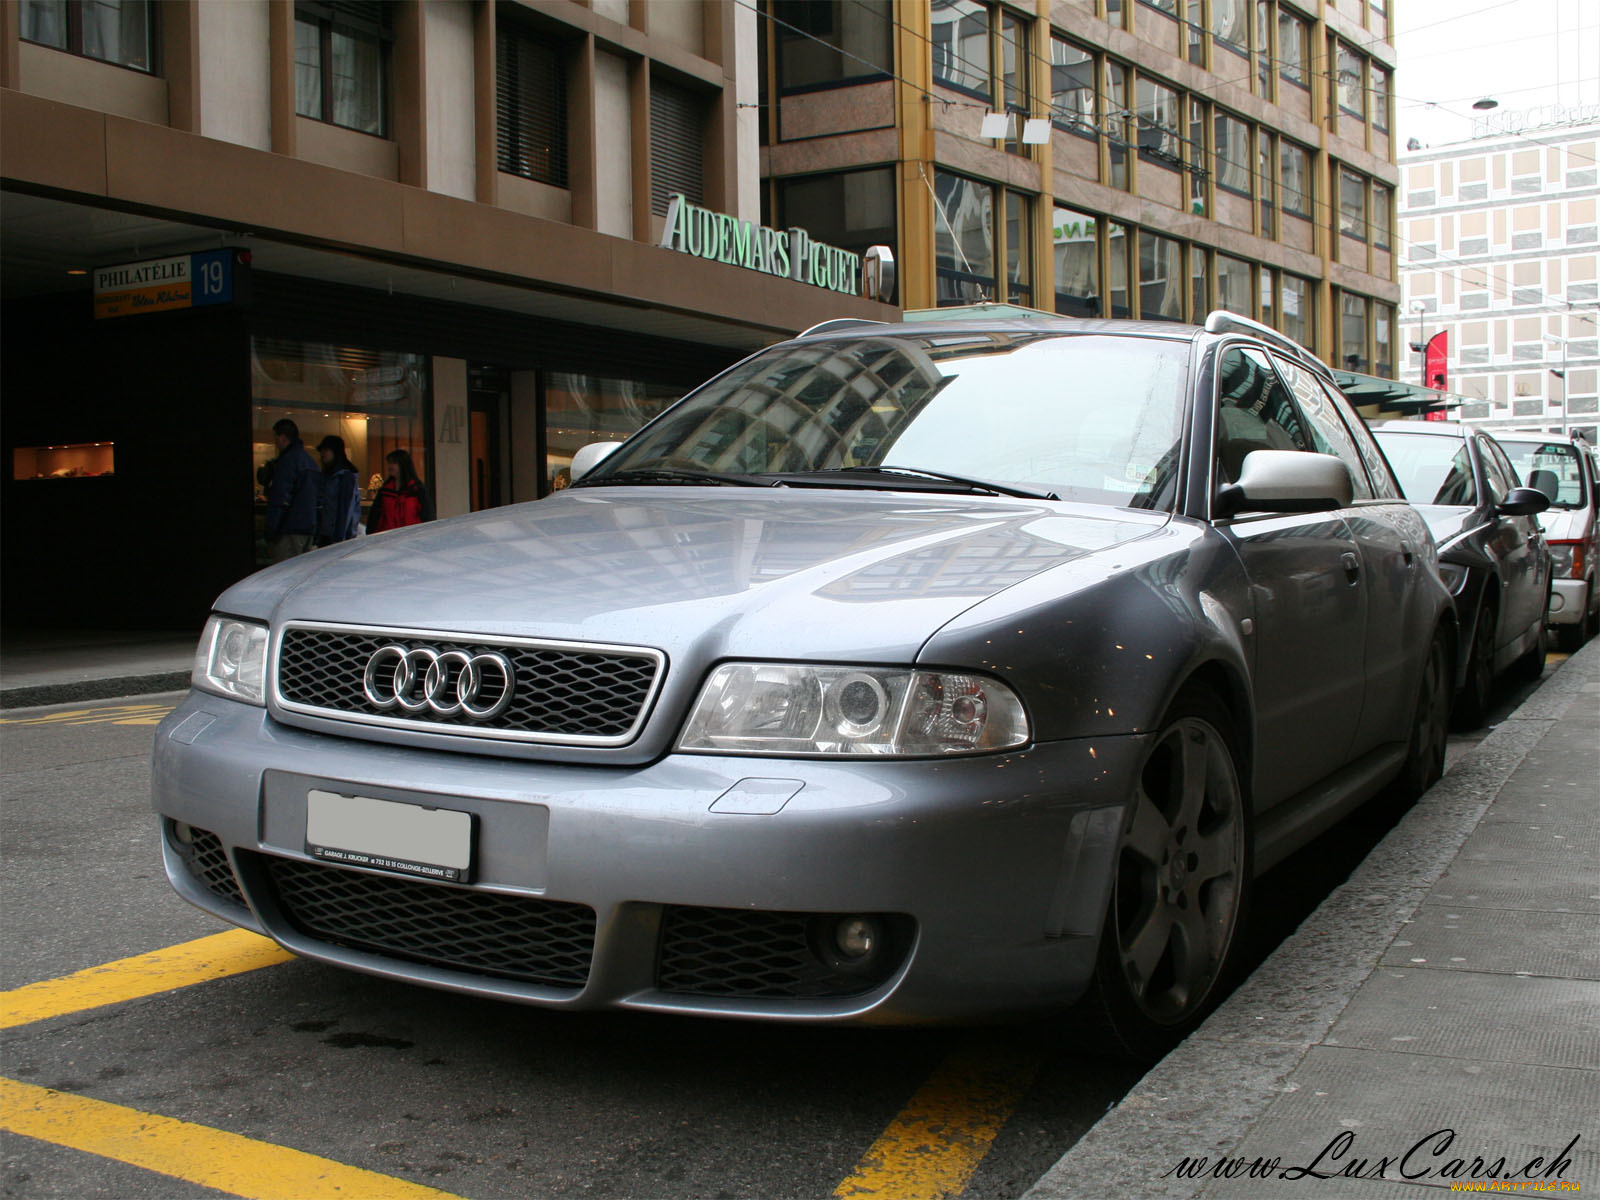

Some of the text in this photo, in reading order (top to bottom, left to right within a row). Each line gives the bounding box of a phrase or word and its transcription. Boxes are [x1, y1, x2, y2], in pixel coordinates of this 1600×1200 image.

[660, 192, 859, 296] AUDEMARS PIGUET
[99, 261, 186, 289] PHILATÉLIE
[200, 260, 224, 295] 19
[324, 850, 343, 859] GARAGE
[348, 854, 369, 863] KRUCKER
